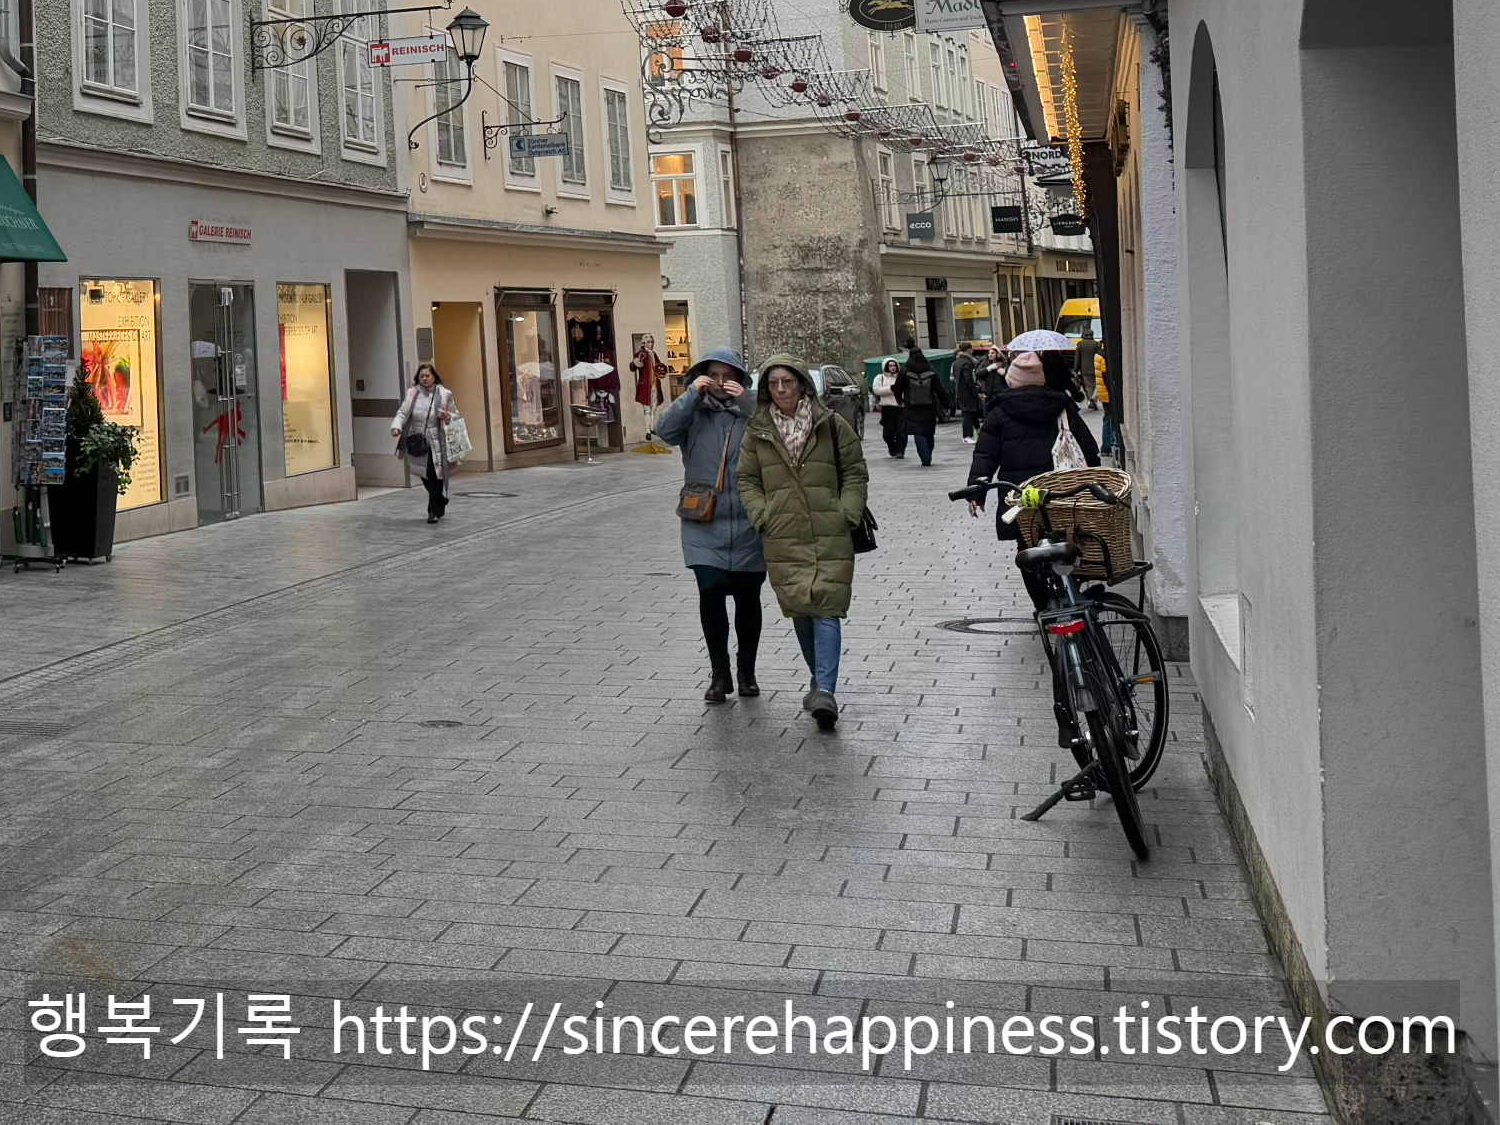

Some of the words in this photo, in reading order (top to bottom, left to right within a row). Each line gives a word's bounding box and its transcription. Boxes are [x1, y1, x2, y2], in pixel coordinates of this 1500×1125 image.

[392, 43, 445, 56] REINISCH
[527, 142, 566, 150] Kantonalbank
[528, 148, 557, 156] Österreich
[199, 224, 224, 237] GALERIE
[225, 227, 252, 240] REINISCH
